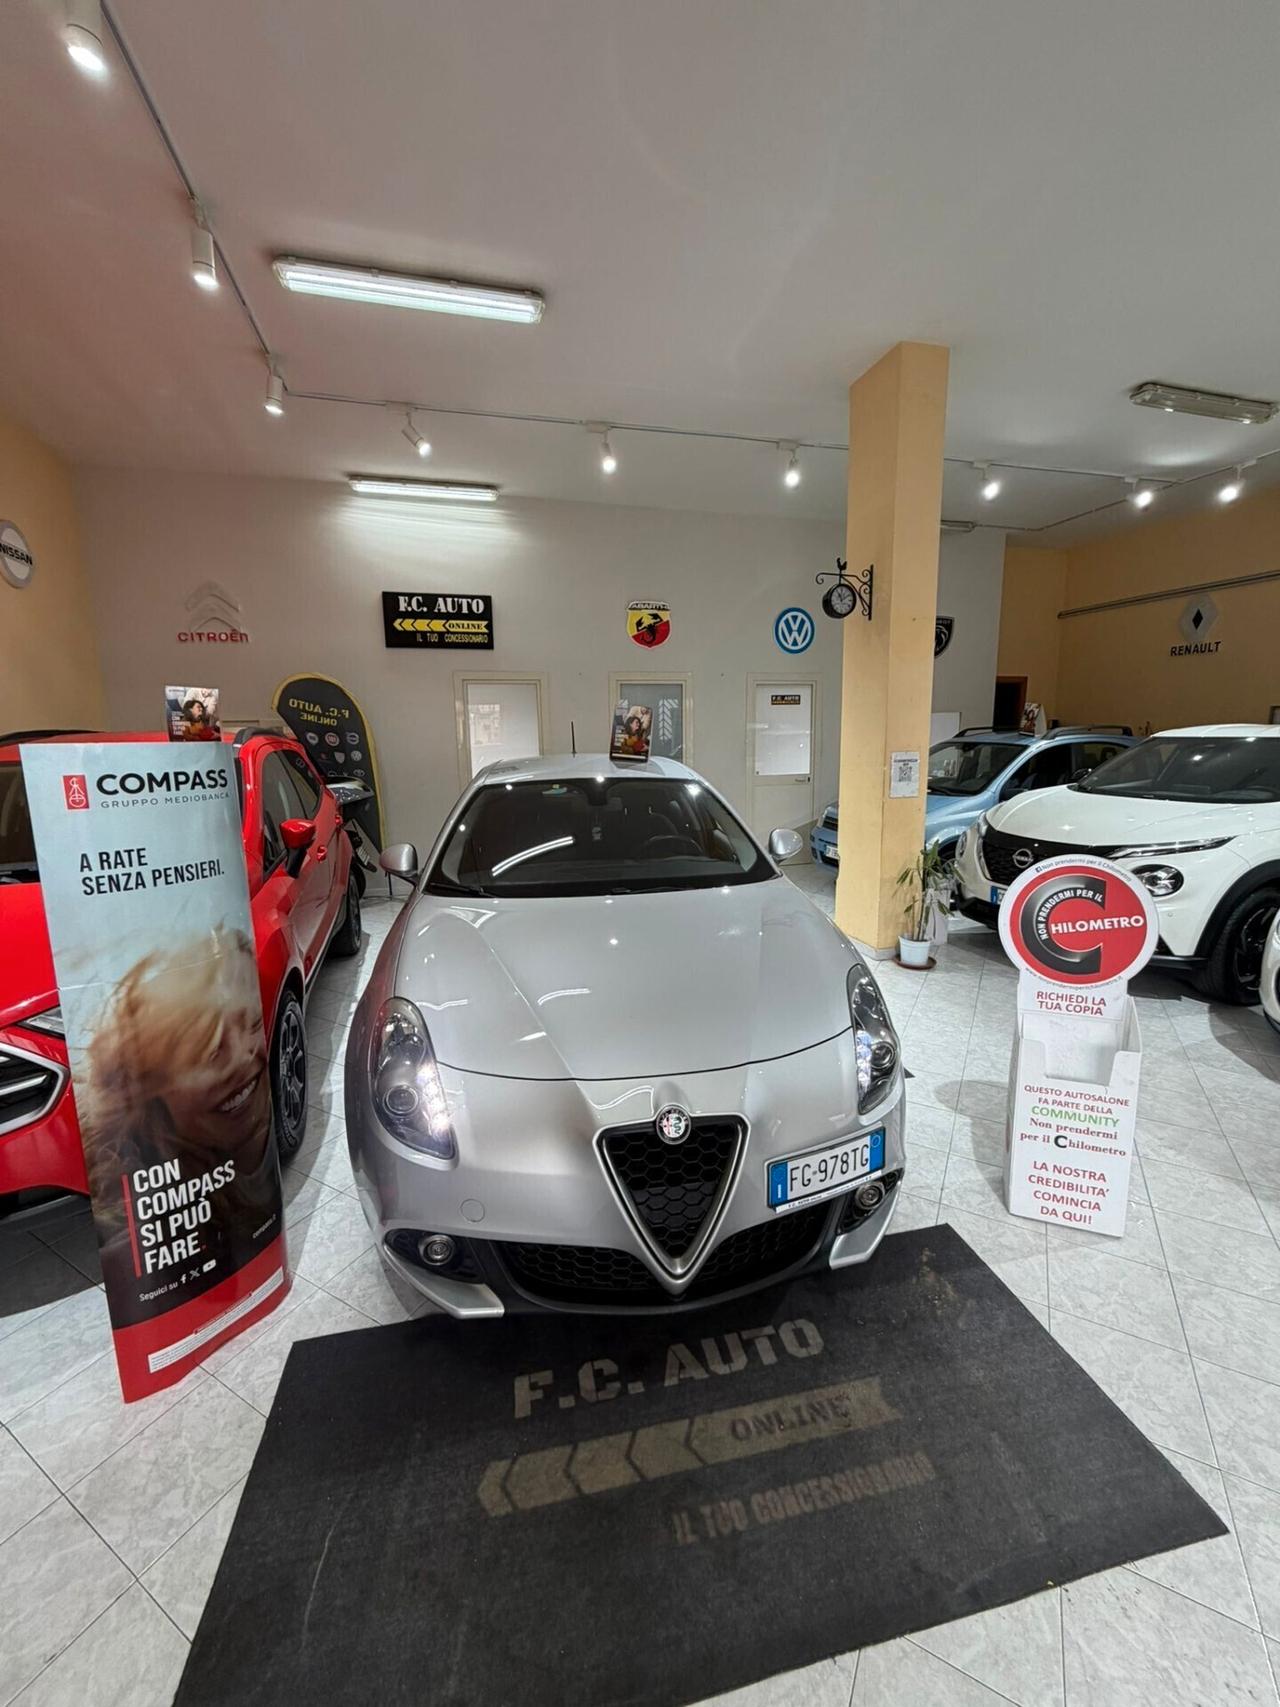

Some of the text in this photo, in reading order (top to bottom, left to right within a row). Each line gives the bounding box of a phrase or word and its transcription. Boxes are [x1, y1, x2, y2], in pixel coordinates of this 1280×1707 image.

[398, 596, 485, 614] F.C. AUTO
[416, 633, 423, 642] IL
[427, 633, 438, 642] TUO
[448, 622, 483, 630] ONLINE
[1170, 640, 1222, 657] RENAULT
[96, 769, 228, 796] COMPASS
[101, 792, 230, 809] GRUPPO MEDIOBANCA
[80, 848, 148, 873] A RATE
[82, 859, 225, 896] SENZA PENSIERI.
[1037, 889, 1103, 940] NON PRENDERMI PER IL
[1036, 991, 1107, 1007] RICHIEDI LA
[1038, 1000, 1104, 1017] TUA COPIA
[1024, 1084, 1131, 1107] QUESTO AUTOSALONE
[1038, 1097, 1113, 1115] FA PARTE DELLA
[1031, 1105, 1120, 1128] COMMUNITY
[1029, 1117, 1118, 1140] Non prendermi
[1020, 1132, 1126, 1157] per il Chilometro
[133, 1158, 181, 1193] CON
[1033, 1160, 1107, 1183] LA NOSTRA
[137, 1160, 235, 1221] COMPASS
[1033, 1190, 1102, 1212] COMINCIA
[140, 1197, 212, 1247] SI PUÒ
[1040, 1205, 1092, 1225] DA QUI!
[139, 1281, 178, 1302] Seguici su
[513, 1318, 825, 1419] F.C. AUTO
[730, 1394, 853, 1443] ONLINE
[672, 1509, 698, 1546] IL
[701, 1499, 749, 1539] TUO
